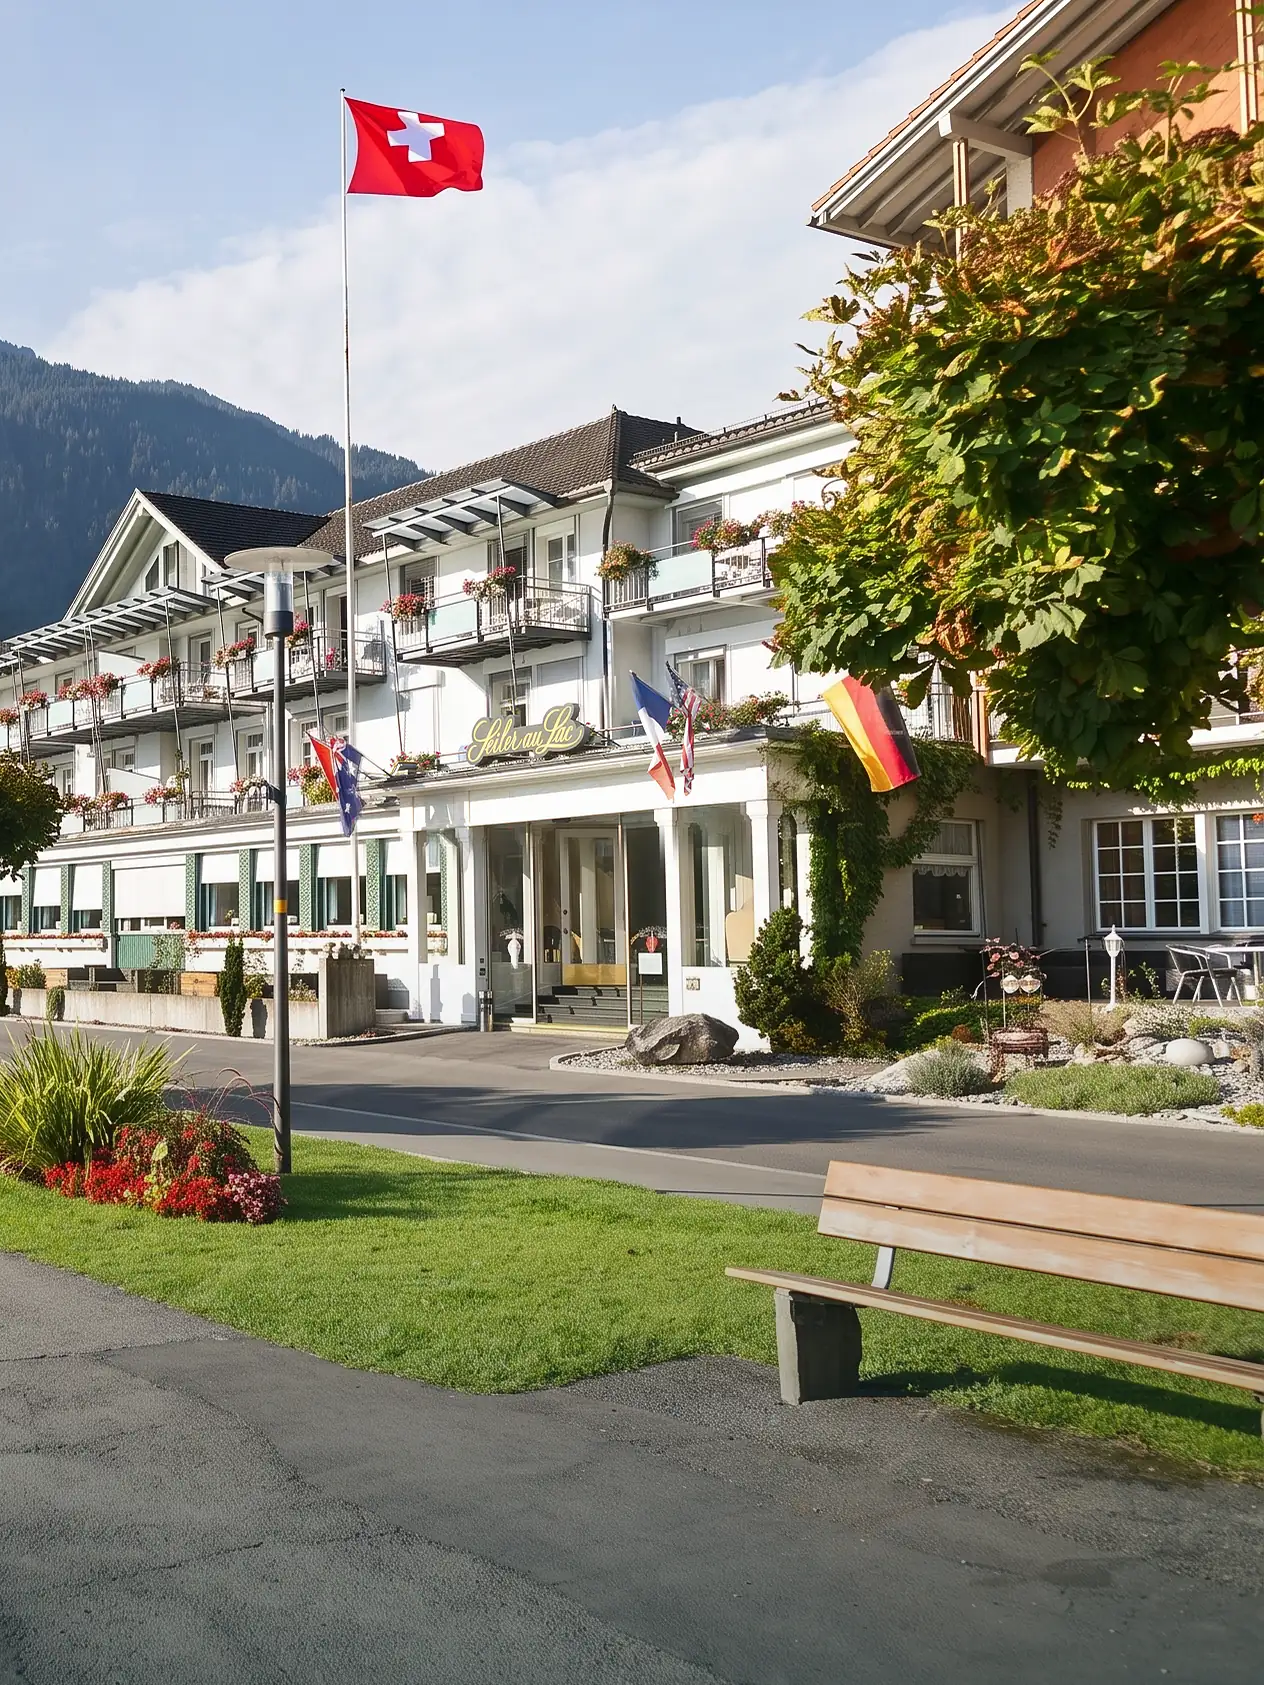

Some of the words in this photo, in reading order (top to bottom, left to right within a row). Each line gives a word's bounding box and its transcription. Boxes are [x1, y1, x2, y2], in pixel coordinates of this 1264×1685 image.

[468, 718, 521, 763] Seiler
[522, 731, 543, 749] au
[535, 705, 582, 755] Lac
